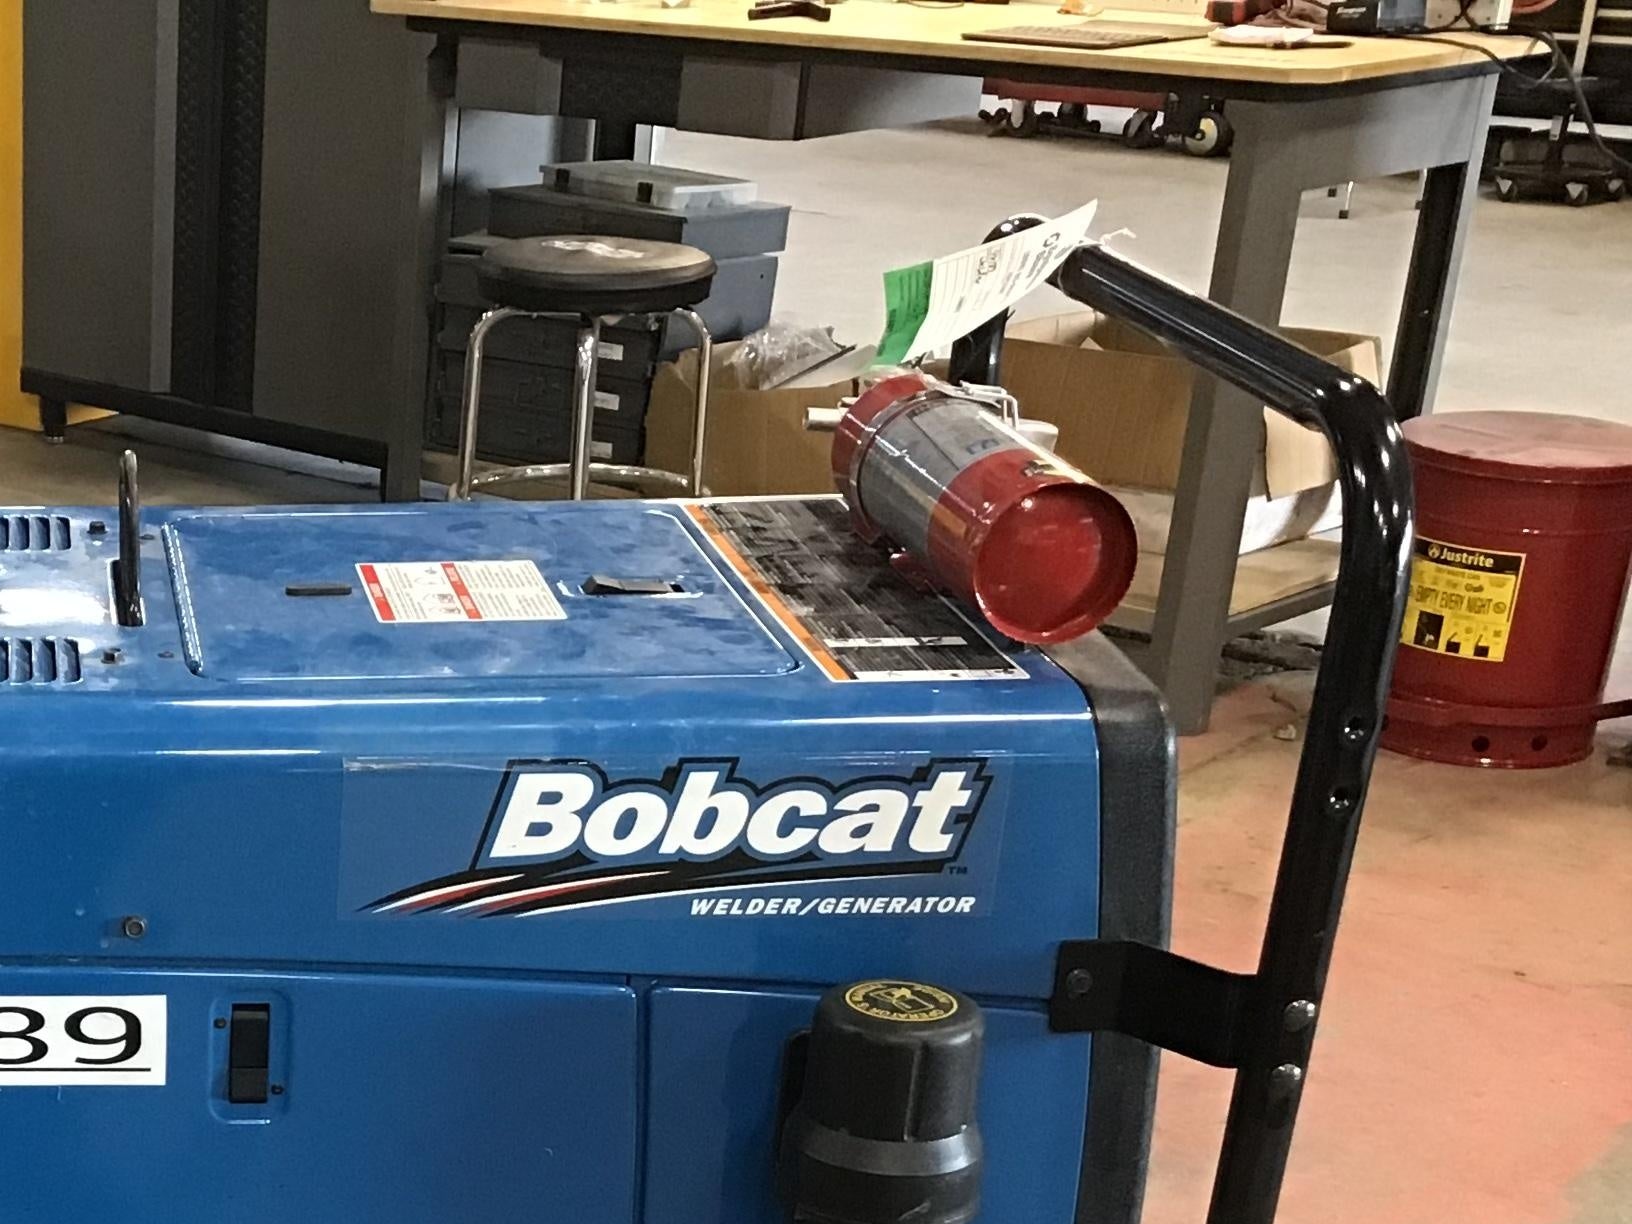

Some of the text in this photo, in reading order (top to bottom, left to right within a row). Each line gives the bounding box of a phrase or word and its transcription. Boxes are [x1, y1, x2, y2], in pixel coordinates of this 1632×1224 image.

[1440, 547, 1495, 568] Justrite
[1440, 591, 1465, 610] EVERY
[1466, 596, 1493, 615] NIGHT
[488, 770, 973, 860] Bobcat
[690, 896, 976, 916] WELDER/GENERATOR
